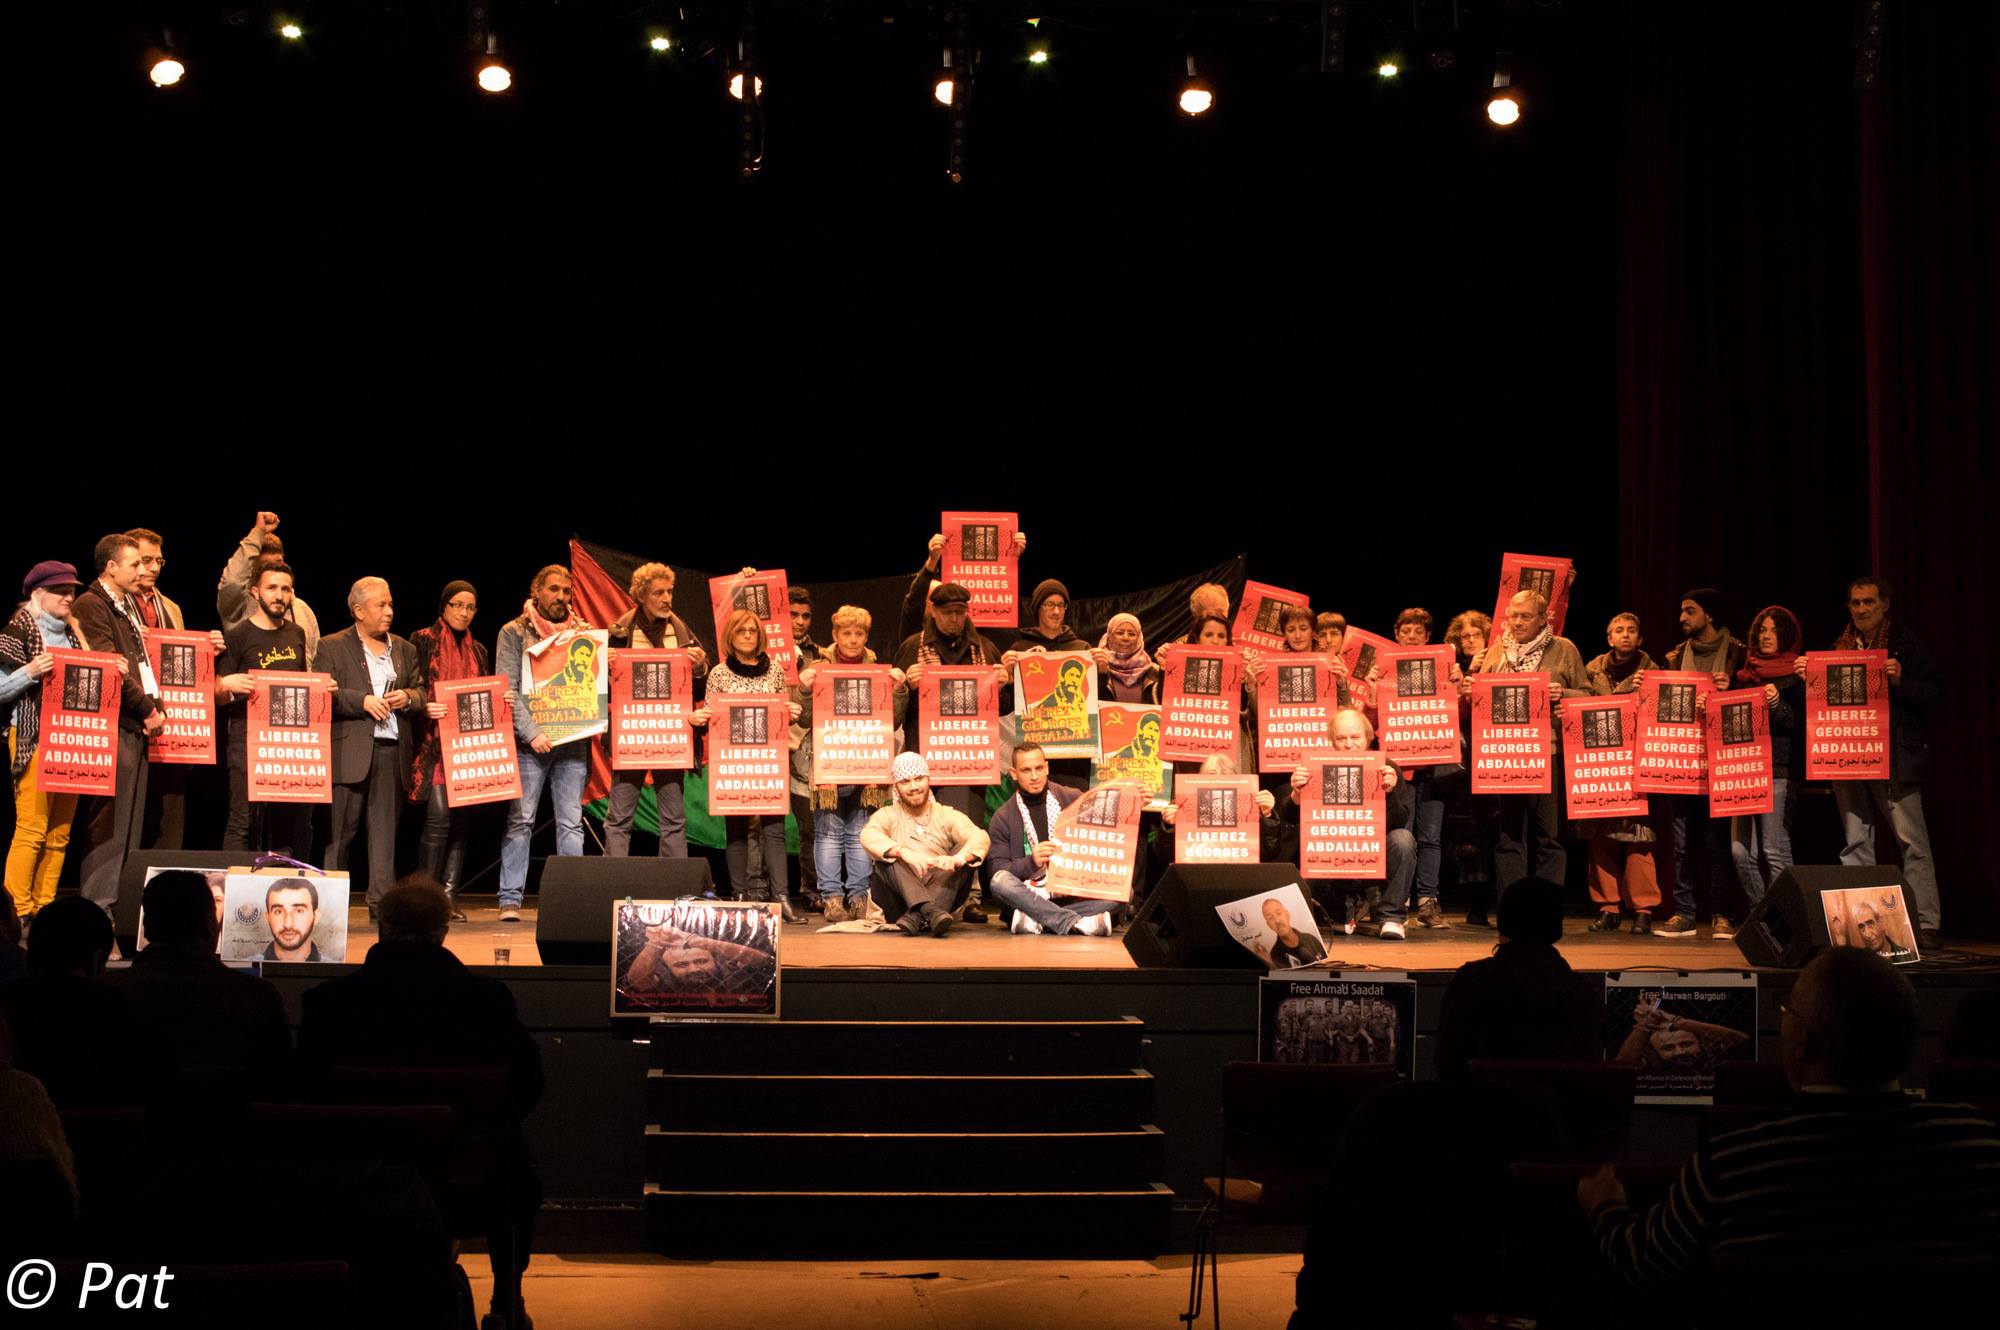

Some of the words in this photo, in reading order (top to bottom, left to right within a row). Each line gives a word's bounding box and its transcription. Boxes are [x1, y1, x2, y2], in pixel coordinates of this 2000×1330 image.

[952, 564, 1006, 574] LIBEREZ
[1240, 632, 1284, 649] LIBERE
[160, 690, 203, 702] IBEREZ
[623, 703, 680, 713] LIBEREZ
[1172, 697, 1228, 709] LIBEREZ
[1388, 699, 1445, 711] LIBEREZ
[166, 706, 205, 719] ORGES
[1170, 711, 1229, 724] GEORGES
[1269, 707, 1325, 717] LIBEREZ
[1817, 709, 1876, 720] LIBEREZ
[52, 714, 108, 729] LIBEREZ
[621, 718, 682, 728] GEORGES
[824, 719, 881, 729] LIBEREZ
[930, 720, 986, 730] LIBEREZ
[1022, 718, 1082, 731] GEORGES
[1387, 714, 1448, 726] GEORGES
[164, 724, 209, 736] DALLAH
[1165, 726, 1232, 739] ABDALLAH
[1268, 722, 1327, 732] GEORGES
[1647, 726, 1703, 738] LIBEREZ
[1815, 725, 1878, 736] GEORGES
[260, 730, 318, 742] LIBEREZ
[1384, 729, 1454, 741] ABDALLAH
[1482, 728, 1538, 738] LIBEREZ
[49, 732, 108, 747] GEORGES
[452, 732, 504, 748] LIBEREZ
[618, 734, 687, 744] ABDALLAH
[823, 734, 883, 744] GEORGES
[929, 735, 989, 744] GEORGES
[258, 747, 320, 758] GEORGES
[1481, 743, 1540, 753] GEORGES
[1644, 742, 1704, 753] GEORGES
[1715, 745, 1761, 760] LIBEREZ
[1812, 742, 1883, 753] ABDALLAH
[44, 750, 112, 766] ABDALLAH
[452, 747, 508, 764] GEORGES
[720, 749, 776, 758] LIBEREZ
[820, 749, 888, 759] ABDALLAH
[926, 750, 994, 760] ABDALLAH
[1574, 750, 1632, 763] LIBEREZ
[718, 764, 778, 773] GEORGES
[1477, 758, 1545, 768] ABDALLAH
[1640, 757, 1708, 769] ABDALLAH
[1715, 760, 1763, 775] GEORGES
[254, 764, 325, 775] ABDALLAH
[451, 762, 514, 780] ABDALLAH
[715, 779, 783, 789] ABDALLAH
[1571, 780, 1632, 794] ABDALLA
[1712, 776, 1767, 792] ABDALLAH
[1312, 809, 1372, 819] LIBEREZ
[1065, 827, 1125, 843] LIBEREZ
[1310, 825, 1374, 835] GEORGES
[1187, 831, 1246, 841] LIBEREZ
[1062, 842, 1124, 859] GEORGES
[1186, 846, 1247, 855] GEORGES
[1306, 842, 1379, 851] ABDALLAH
[1290, 983, 1311, 994] Free
[1314, 984, 1348, 995] Ahmad
[1351, 984, 1384, 995] Saadat
[1640, 989, 1660, 1000] Free
[1662, 992, 1692, 1000] Marwan
[1694, 992, 1726, 1002] Bargouti
